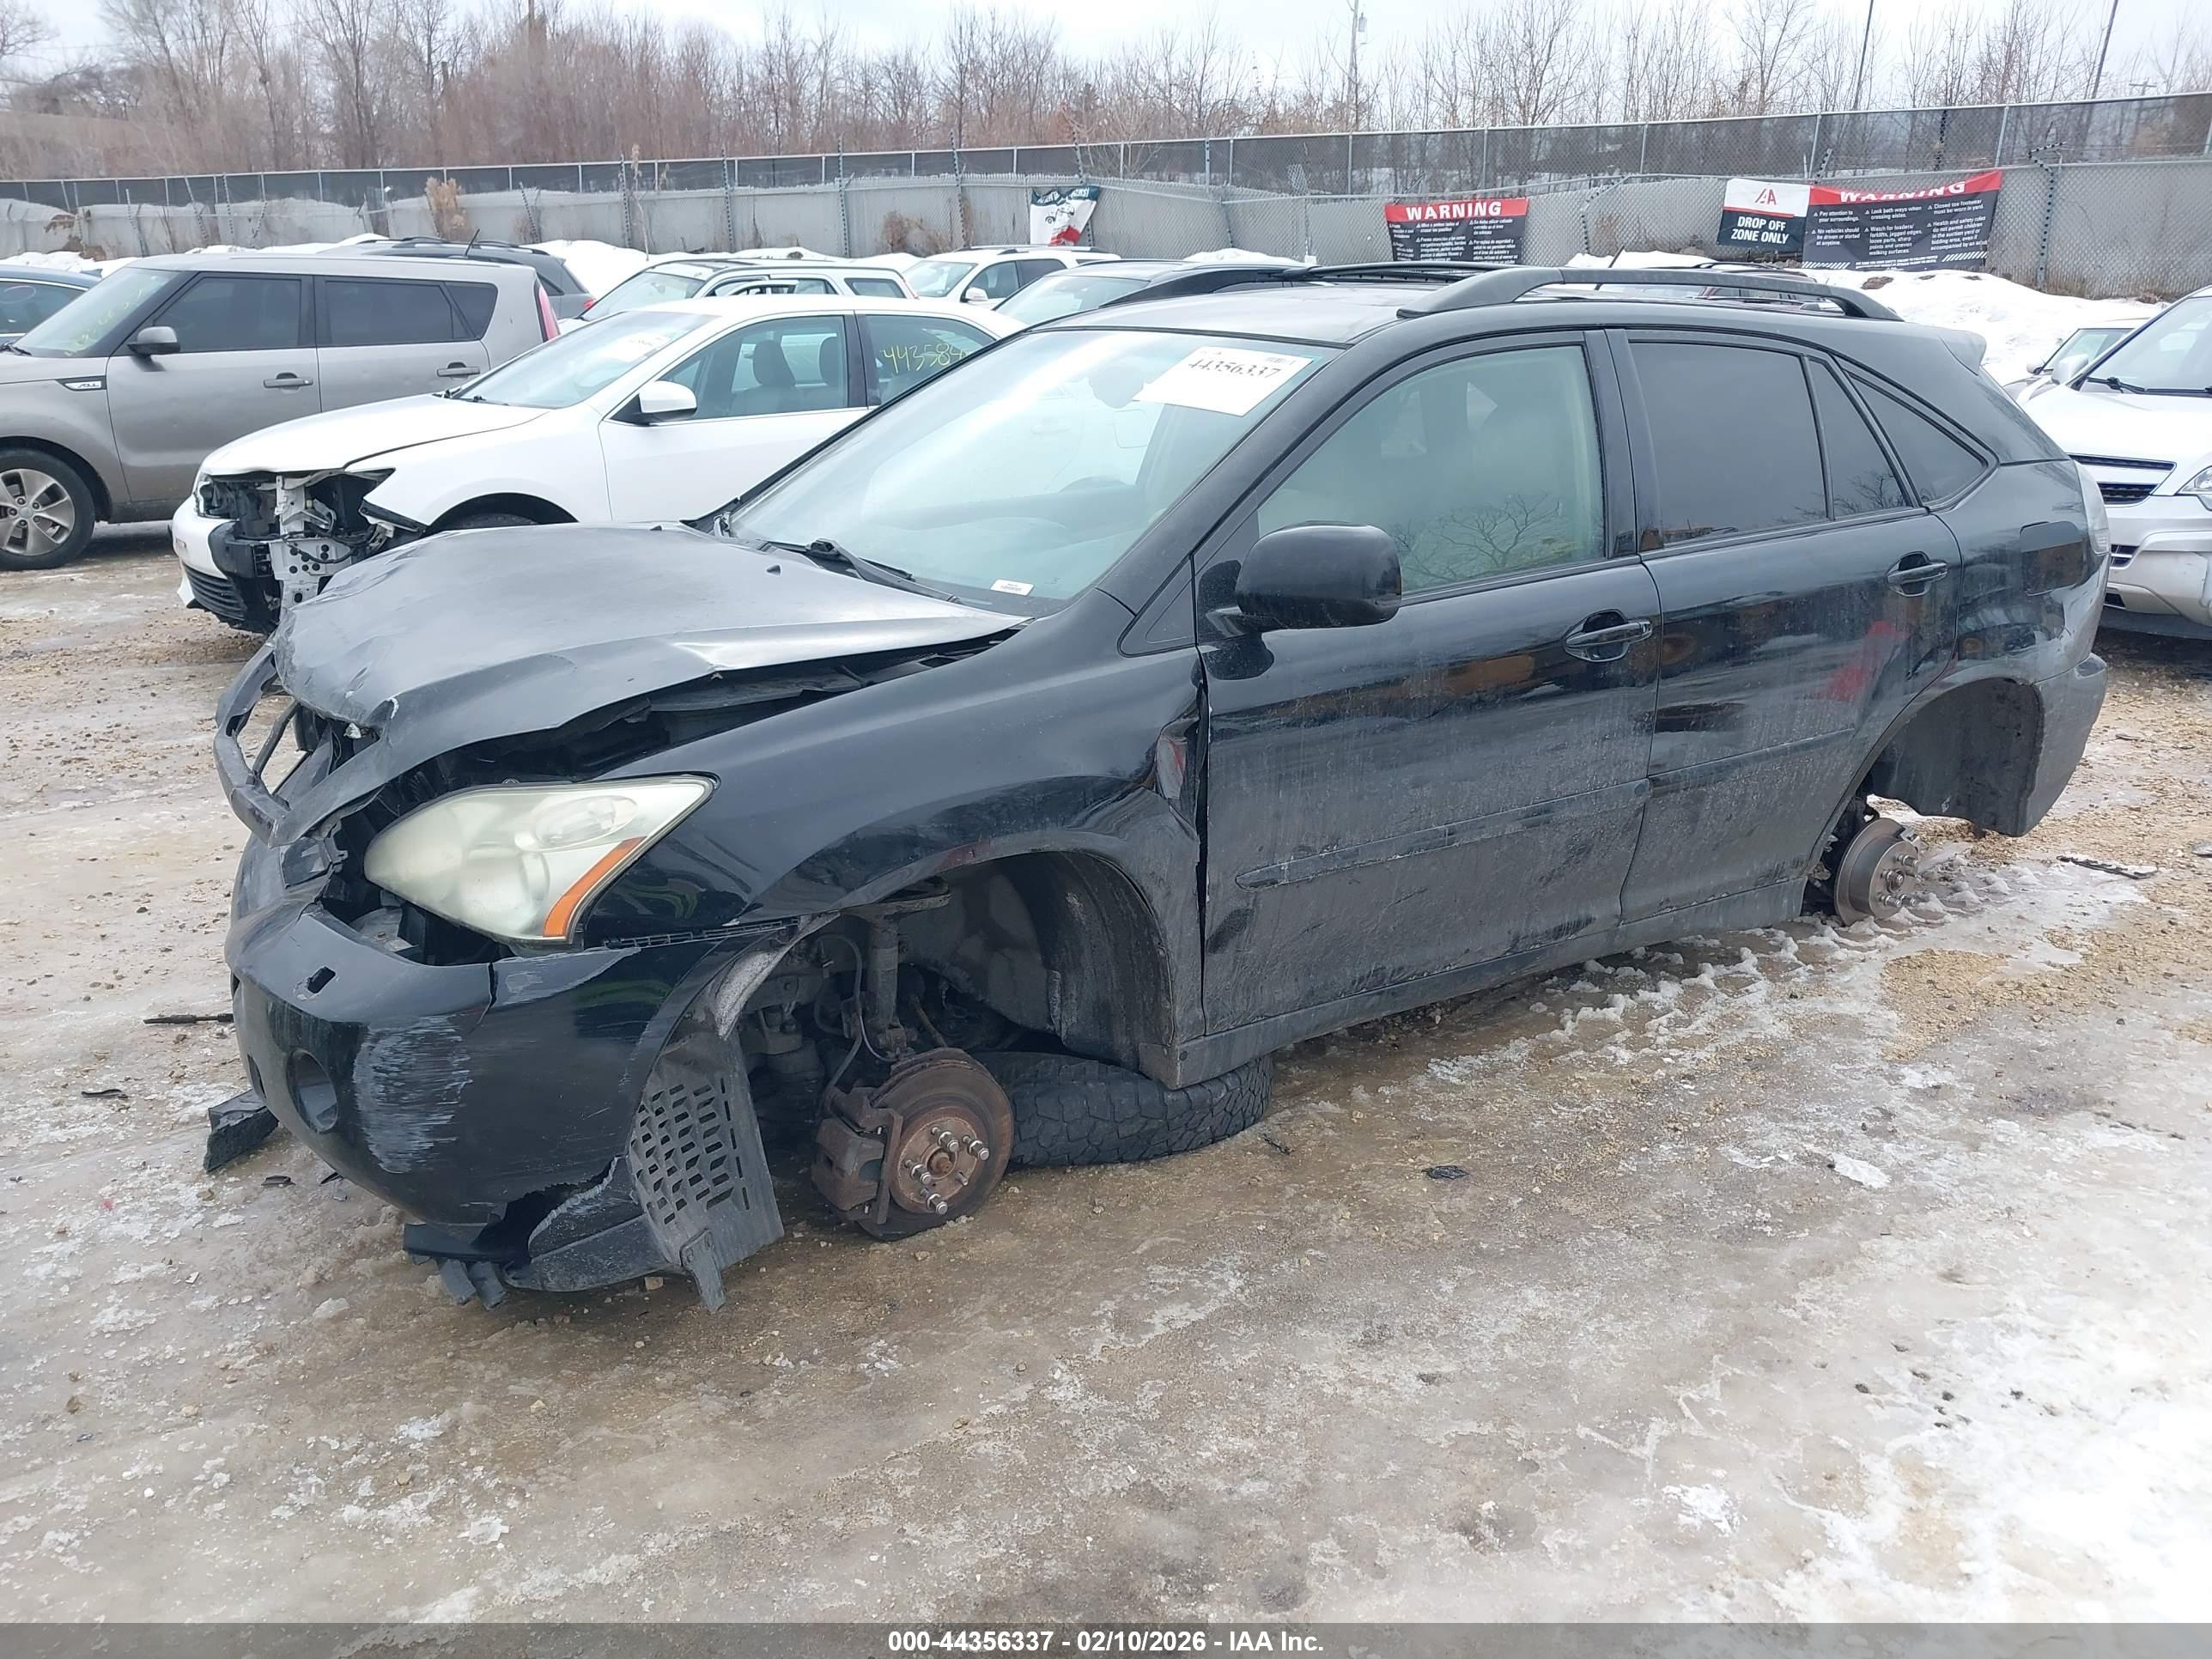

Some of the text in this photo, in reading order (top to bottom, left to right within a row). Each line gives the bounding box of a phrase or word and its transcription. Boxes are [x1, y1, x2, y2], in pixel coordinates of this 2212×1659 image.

[1406, 202, 1502, 220] WARNING
[1737, 216, 1787, 231] DROP OFF
[1731, 228, 1790, 244] ZONE ONLY
[1188, 359, 1281, 378] 44356337
